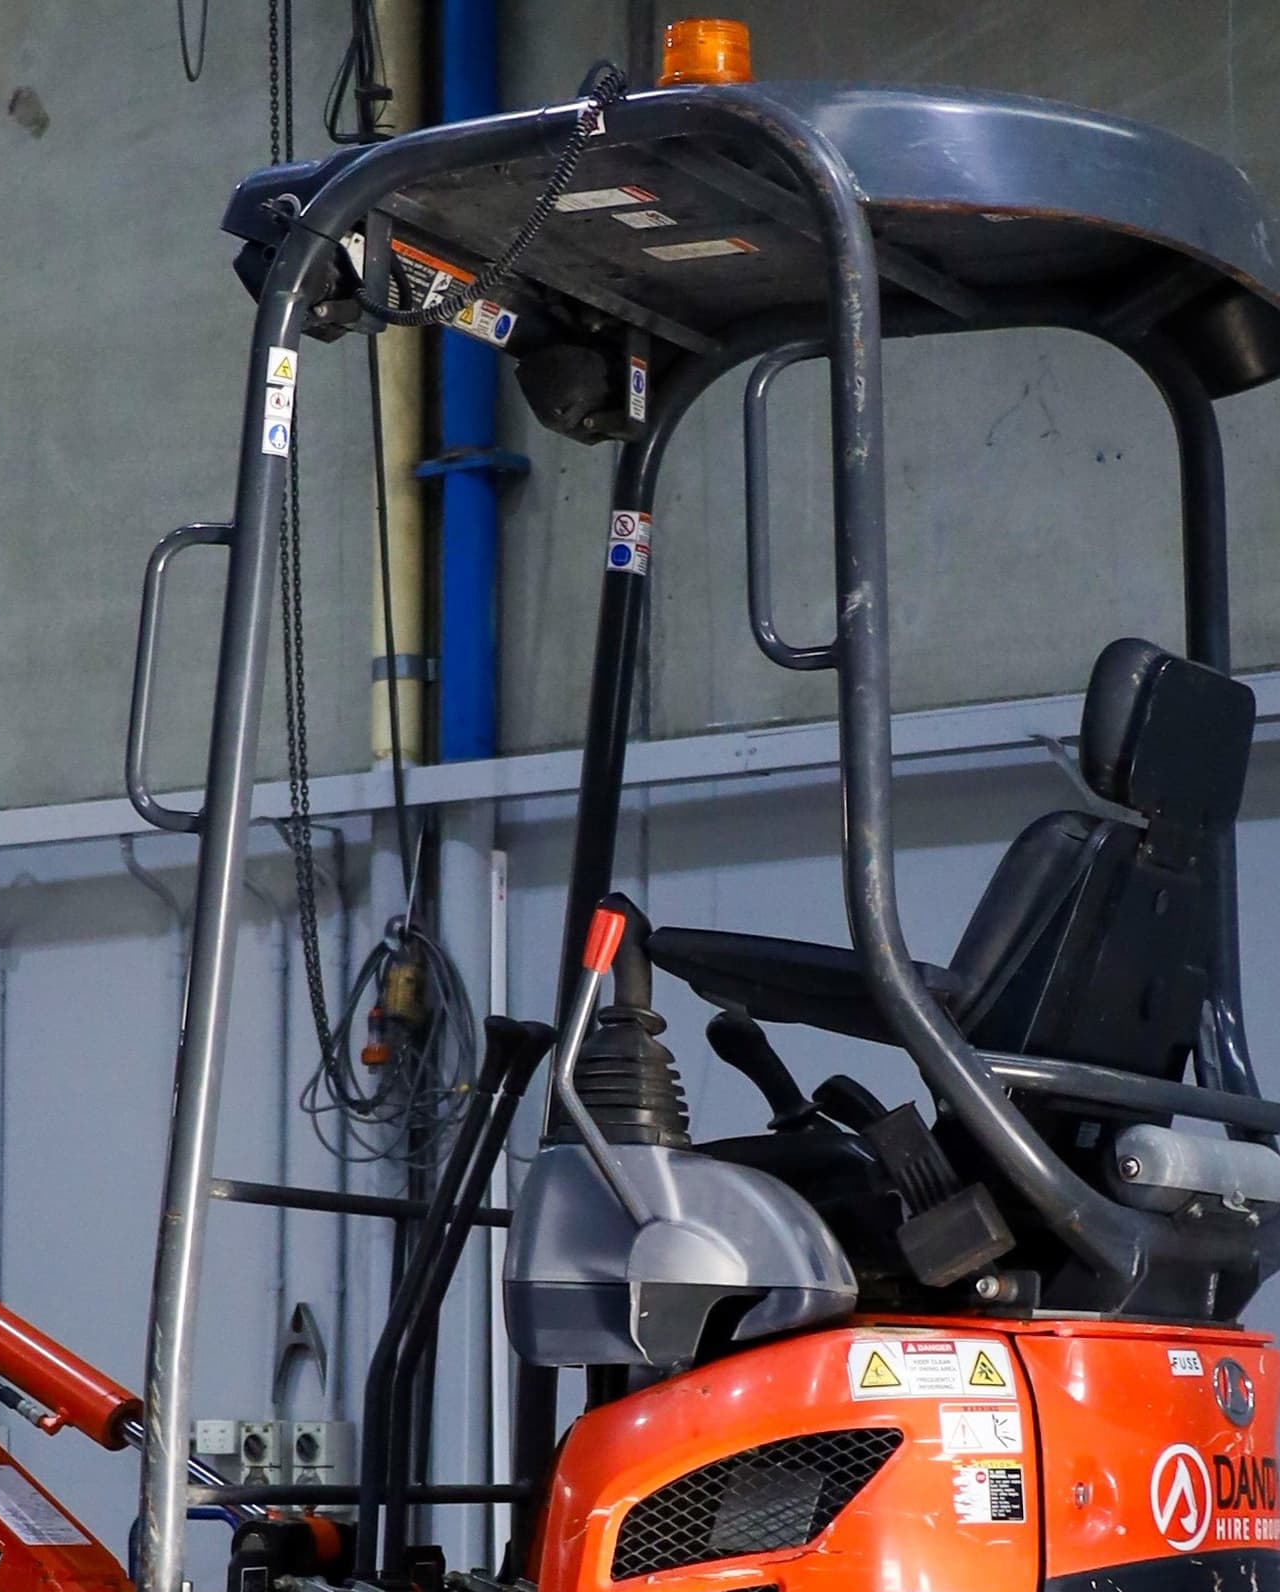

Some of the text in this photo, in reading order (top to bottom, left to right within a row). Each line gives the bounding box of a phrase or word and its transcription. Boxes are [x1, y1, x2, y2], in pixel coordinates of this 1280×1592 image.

[917, 1344, 953, 1352] DANGER
[1172, 1357, 1200, 1371] FUSE
[1213, 1455, 1280, 1510] DAND
[1216, 1518, 1250, 1540] HIRE
